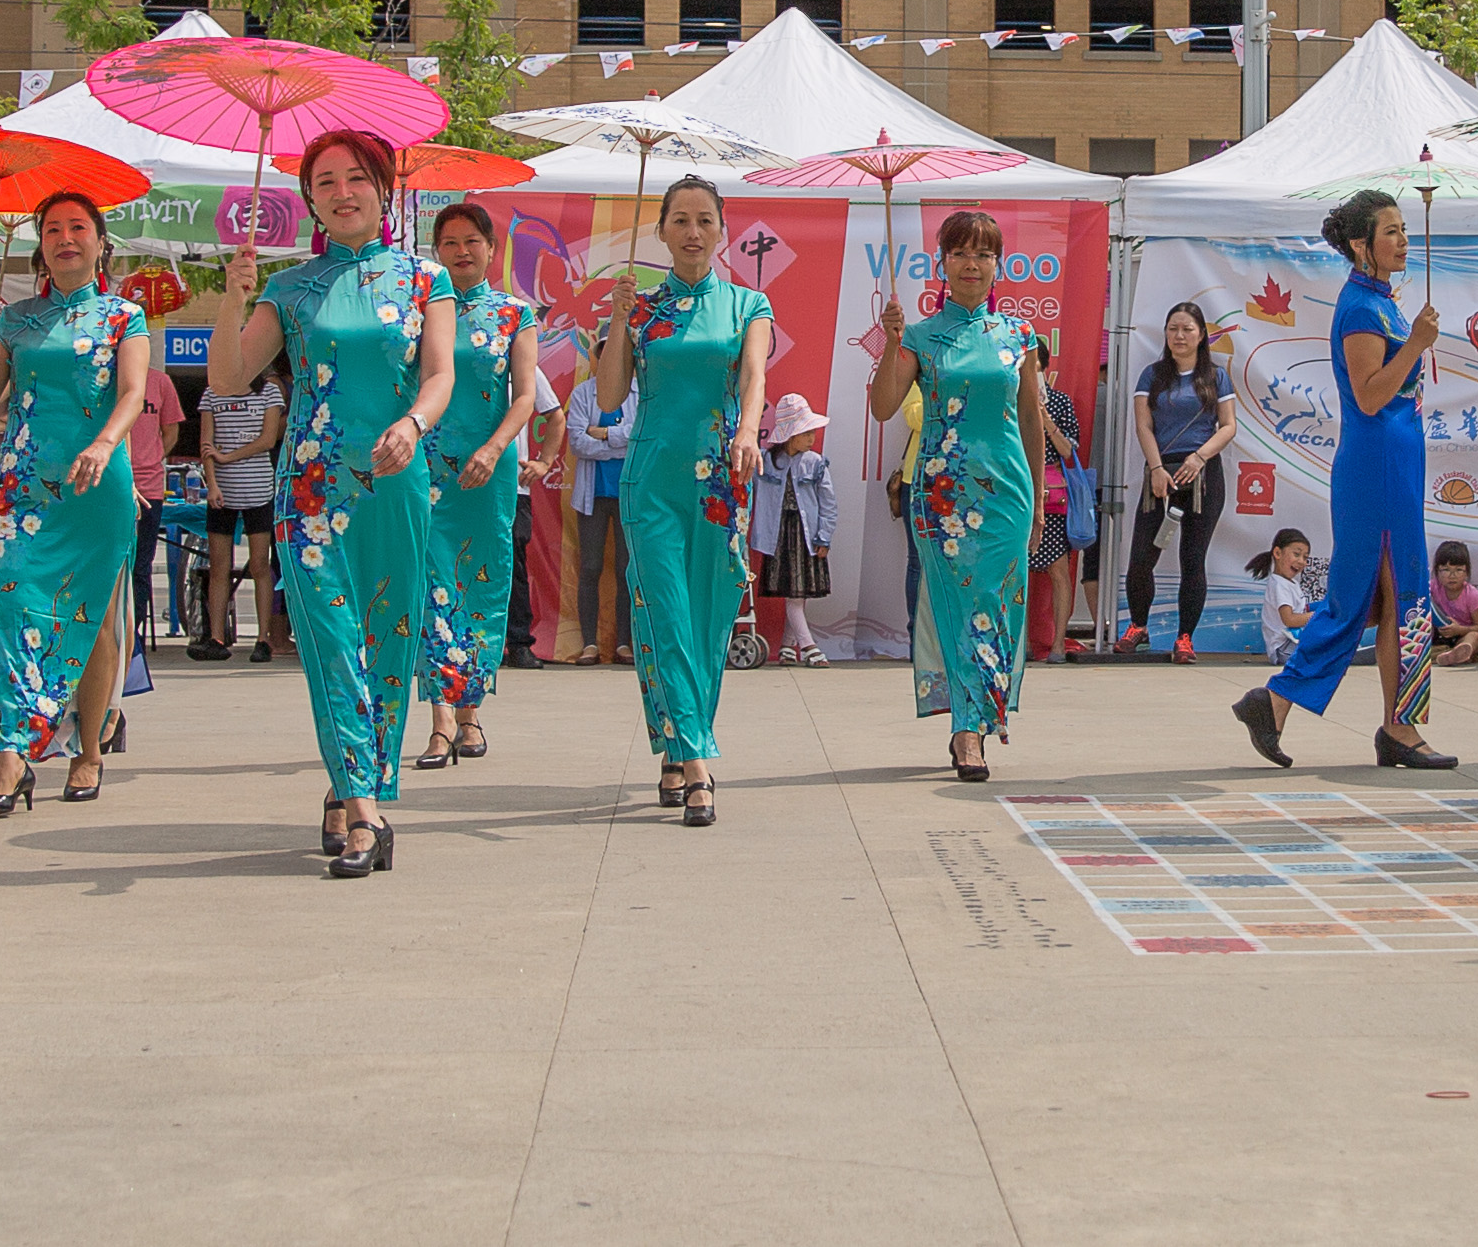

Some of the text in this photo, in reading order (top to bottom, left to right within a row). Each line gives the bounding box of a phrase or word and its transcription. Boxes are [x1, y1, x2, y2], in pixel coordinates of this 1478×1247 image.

[420, 192, 451, 205] rloo
[103, 196, 201, 225] ESTIVITY
[917, 288, 1061, 320] Cese
[1282, 431, 1336, 448] WCCA
